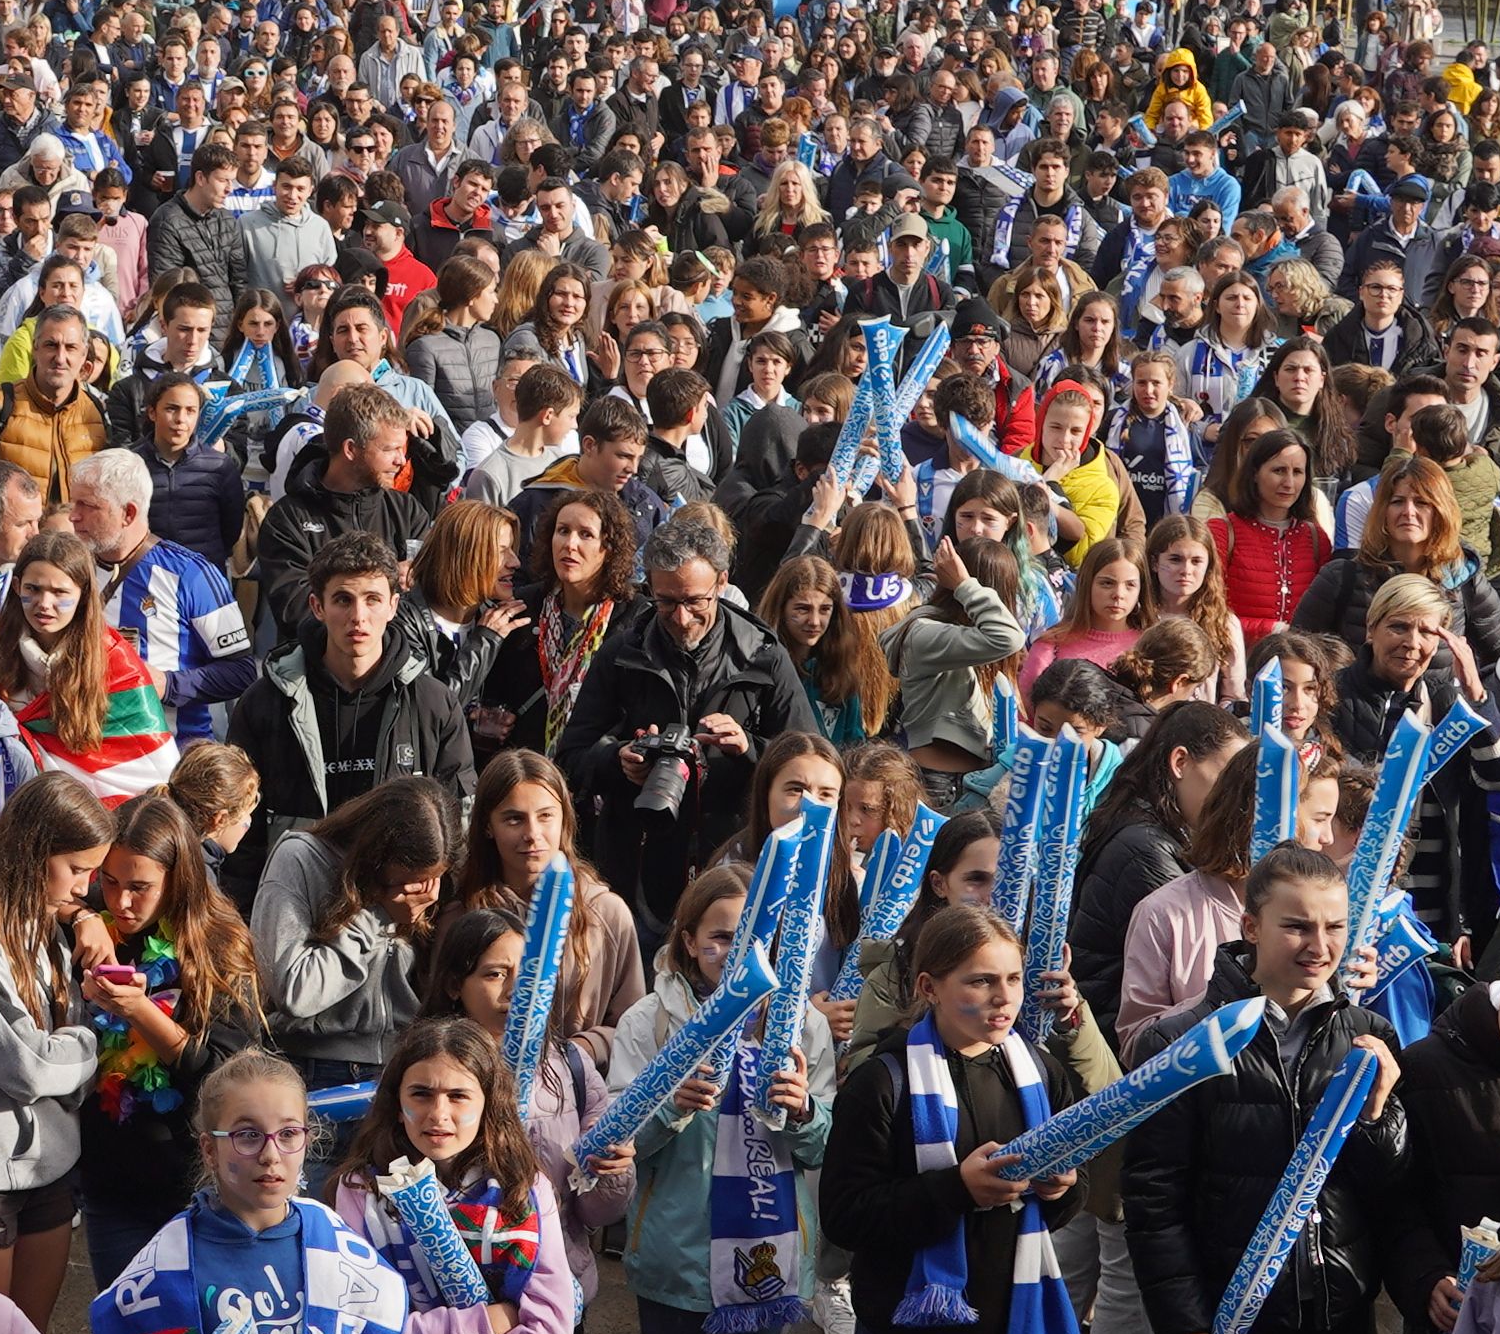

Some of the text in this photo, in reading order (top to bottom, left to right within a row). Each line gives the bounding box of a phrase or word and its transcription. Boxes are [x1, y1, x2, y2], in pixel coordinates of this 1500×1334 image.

[877, 328, 889, 361] eitb
[1436, 720, 1471, 755] eitb
[1011, 747, 1034, 799] eitb
[890, 842, 922, 889] eitb
[1377, 944, 1411, 980] eitb
[1128, 1054, 1170, 1091] eitb
